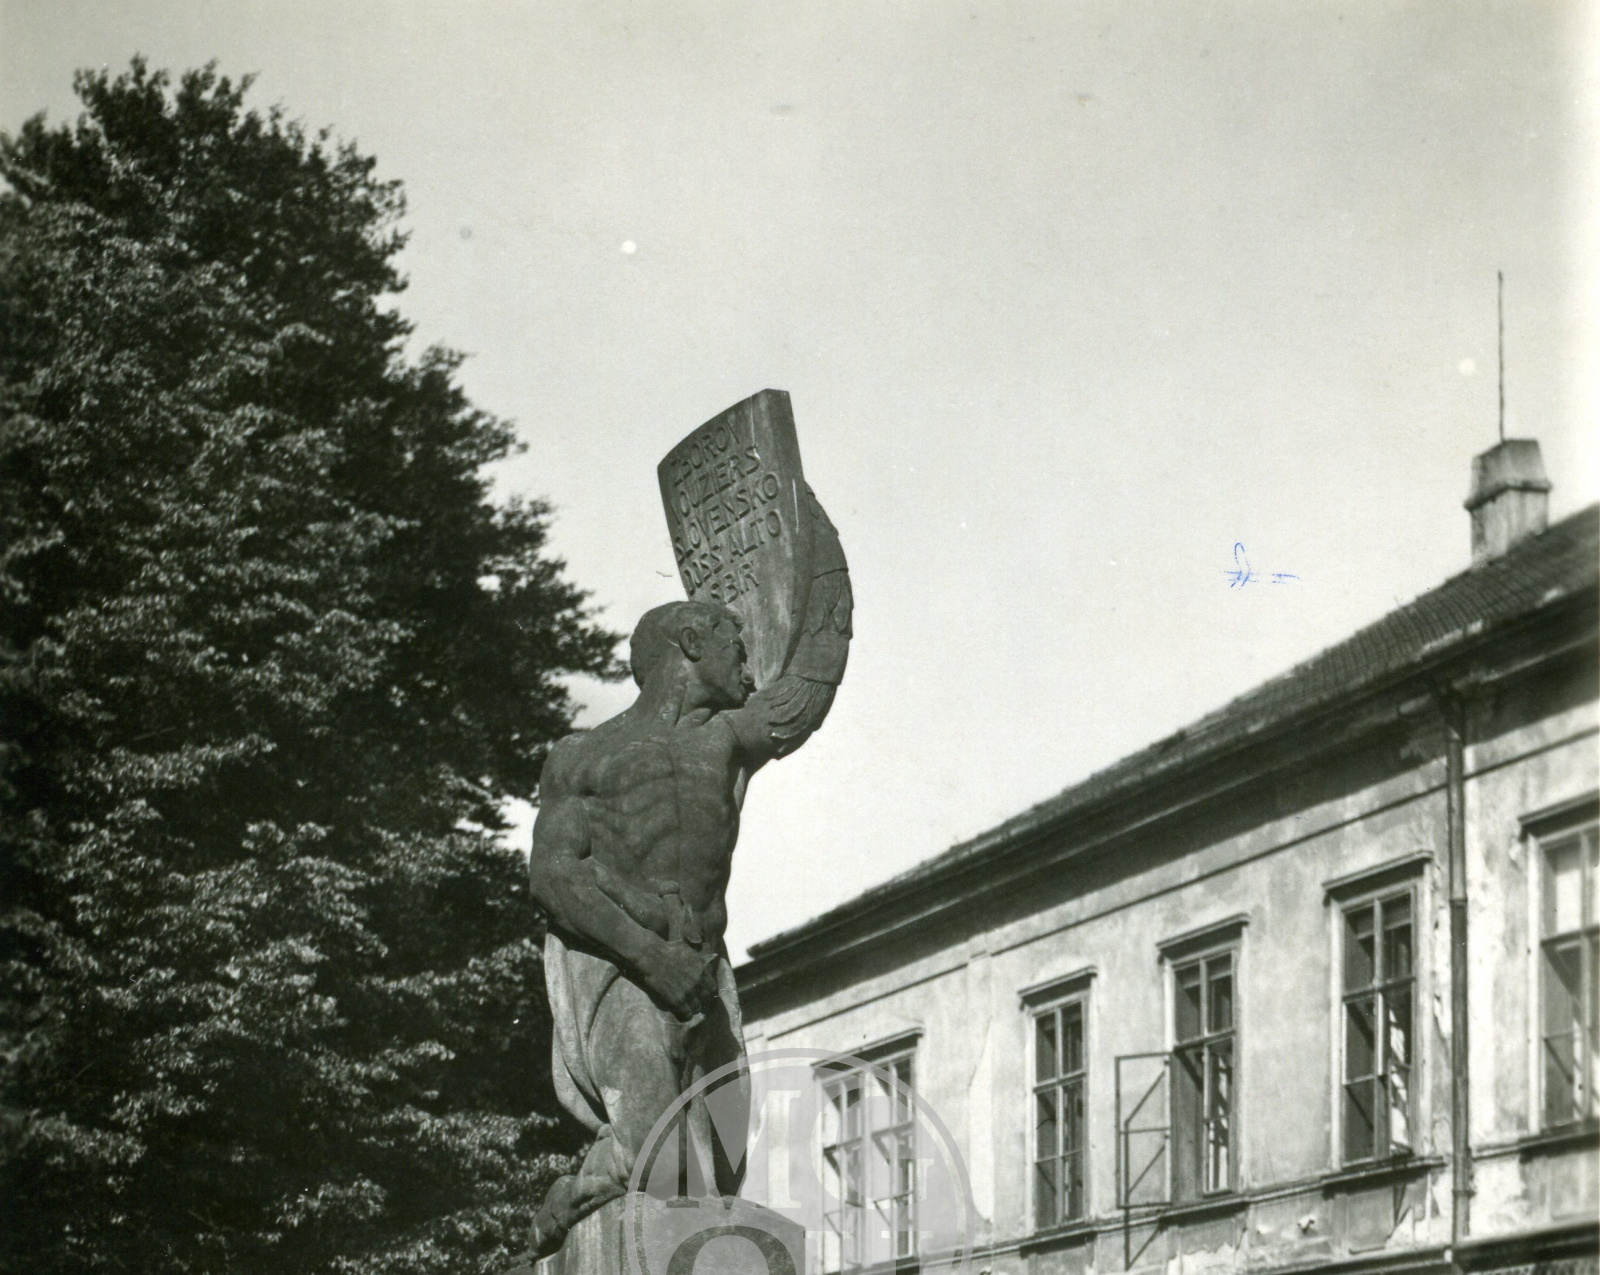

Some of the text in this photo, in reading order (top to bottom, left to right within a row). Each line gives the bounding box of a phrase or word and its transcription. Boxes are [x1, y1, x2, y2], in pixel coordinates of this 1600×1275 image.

[674, 472, 781, 567] SLOVENSKO
[683, 508, 783, 598] DOSS ALTO
